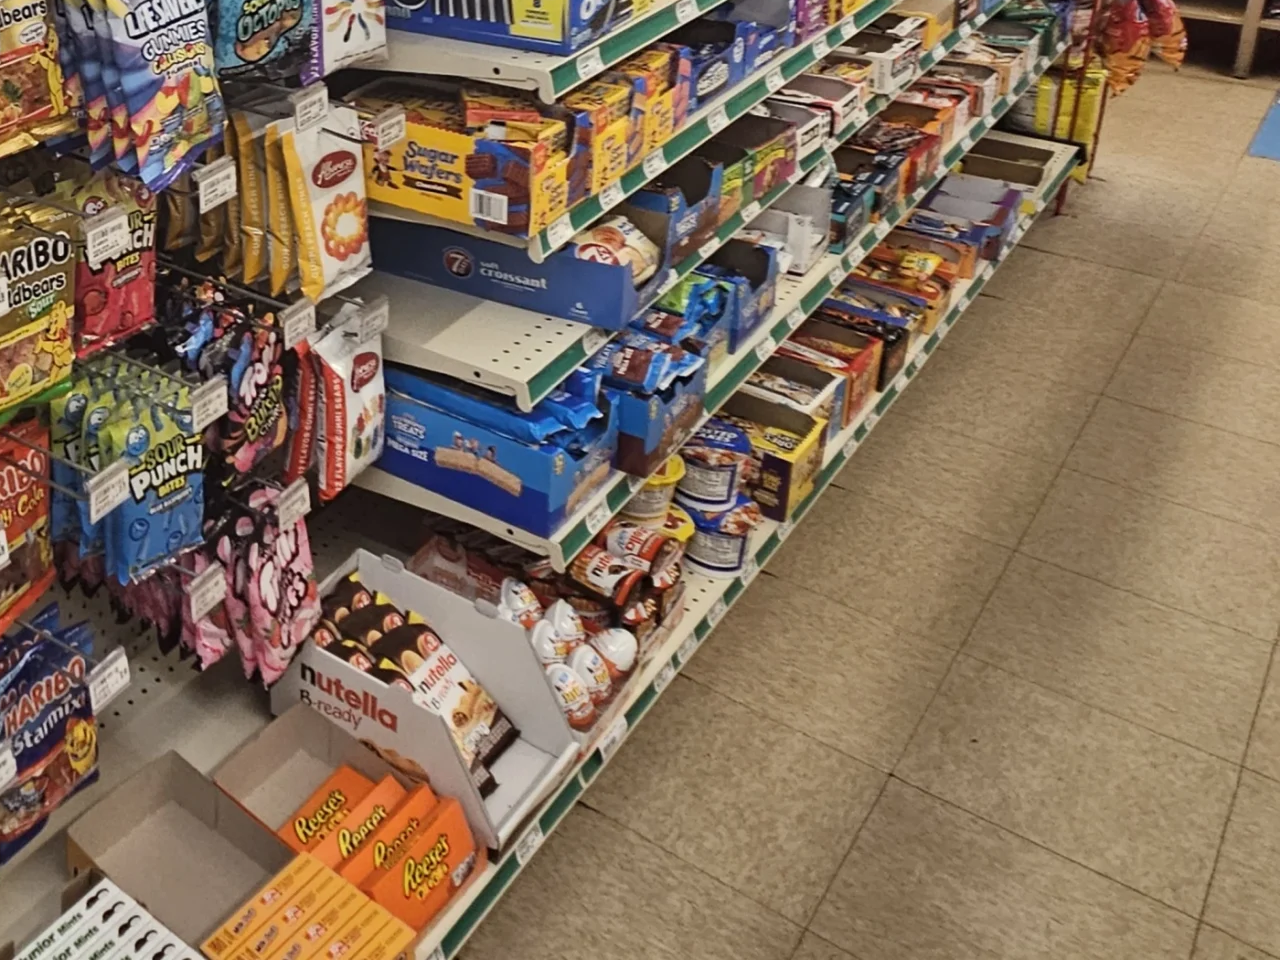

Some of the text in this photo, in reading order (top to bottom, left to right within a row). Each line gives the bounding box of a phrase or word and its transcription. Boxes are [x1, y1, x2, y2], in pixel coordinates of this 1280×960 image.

[141, 20, 206, 62] GUMMIES
[402, 155, 464, 185] Wafers
[404, 140, 460, 169] Sugar
[304, 208, 315, 239] PEACH
[309, 239, 321, 280] GUMMI
[448, 253, 463, 273] 7
[479, 259, 500, 270] soft
[478, 268, 549, 291] croissant
[26, 293, 57, 318] Sour
[391, 417, 427, 441] TREATS
[144, 434, 187, 470] SOUR
[334, 442, 345, 481] FLAVOR
[409, 447, 430, 463] SIZE
[129, 443, 203, 501] PUNCH
[158, 475, 186, 498] BITES
[418, 651, 459, 696] nutella
[2, 654, 87, 739] HARIBO
[299, 661, 400, 735] nutella
[299, 688, 364, 731] B-ready
[11, 692, 84, 757] Starmix
[293, 789, 348, 845] Reese's
[403, 832, 451, 898] Reese's
[56, 912, 84, 937] Mints
[73, 925, 100, 951] Mints
